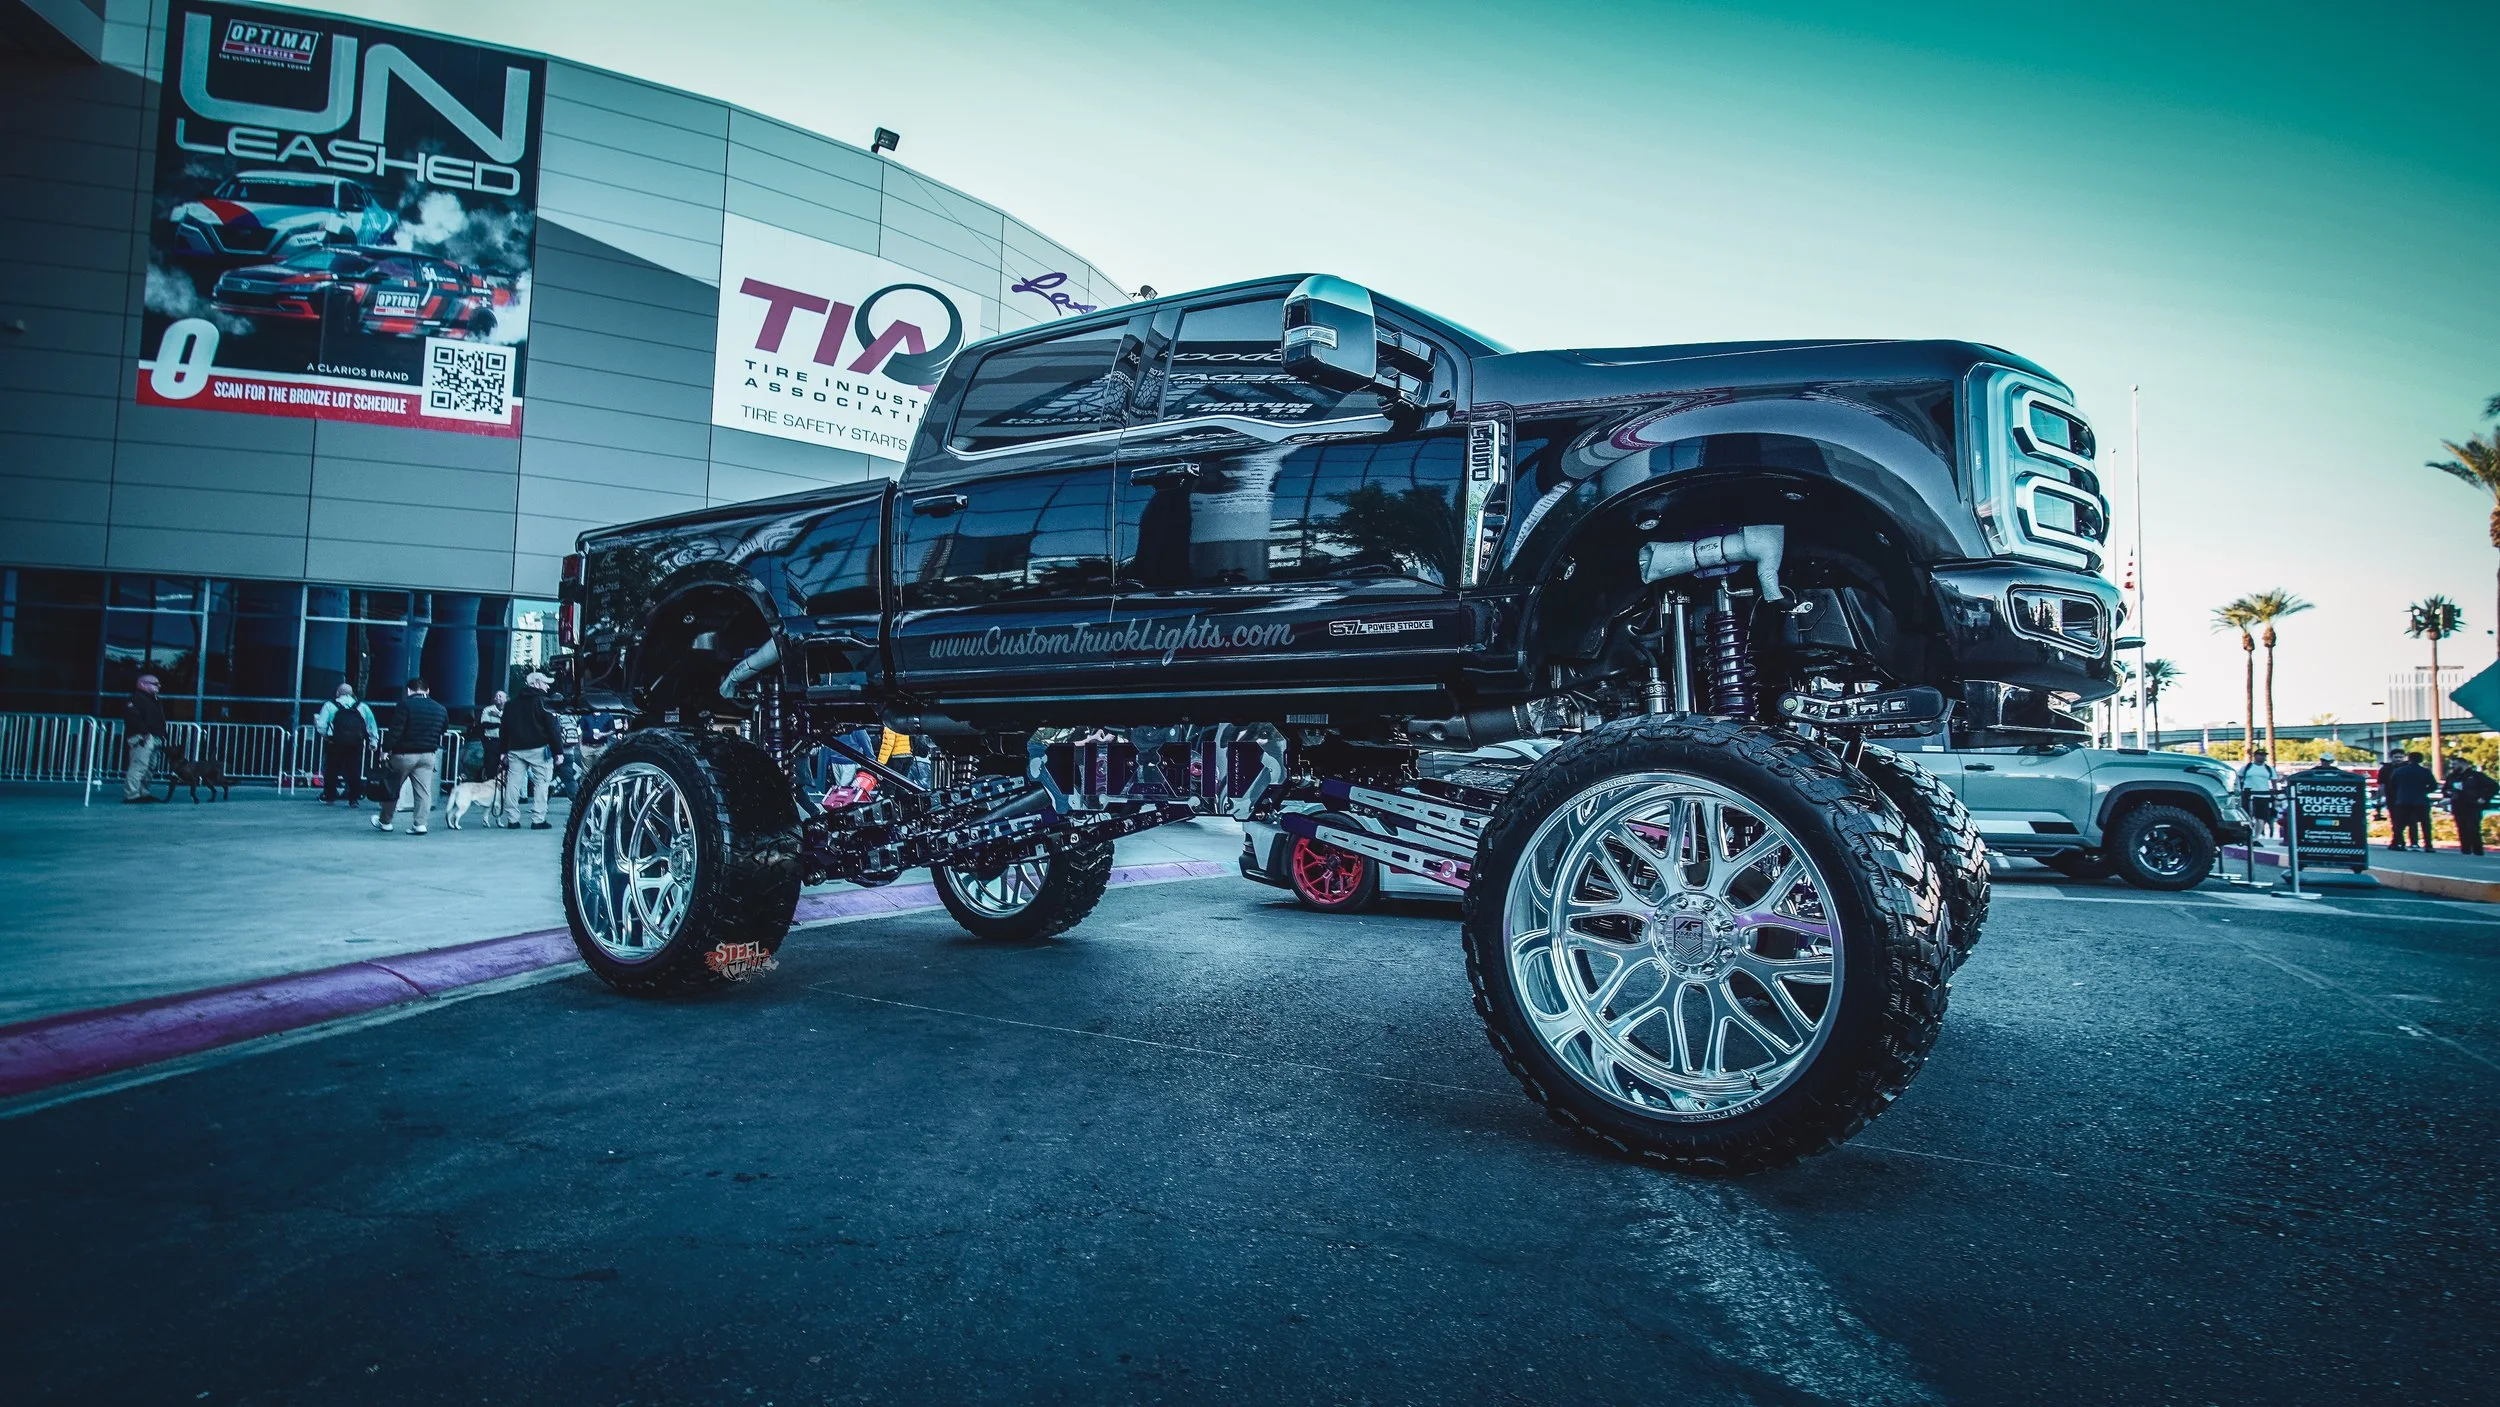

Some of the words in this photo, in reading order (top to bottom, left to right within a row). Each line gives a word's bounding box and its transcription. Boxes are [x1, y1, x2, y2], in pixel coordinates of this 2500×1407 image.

[231, 25, 312, 51] OPTIMA
[180, 12, 531, 164] UN
[176, 117, 521, 197] LEASHED
[378, 292, 417, 308] OPTIMA
[740, 277, 936, 394] TIA
[306, 362, 315, 371] A
[317, 363, 367, 377] CLARIOS
[370, 369, 409, 381] BRAND
[744, 359, 808, 382] TIRE
[214, 381, 243, 399] SCAN
[245, 384, 265, 400] FOR
[268, 386, 287, 402] THE
[289, 388, 331, 406] BRONZE
[333, 392, 352, 408] LOT
[353, 394, 407, 414] SCHEDULE
[744, 377, 922, 423] ASSOCIATI
[741, 404, 778, 424] TIRE
[783, 414, 846, 437] SAFETY
[851, 427, 908, 451] STARTS
[929, 615, 1296, 666] www.CustomTruckLights.com
[1368, 623, 1396, 631] POWER
[1398, 621, 1431, 630] STROKE
[2302, 804, 2352, 813] COFFEE
